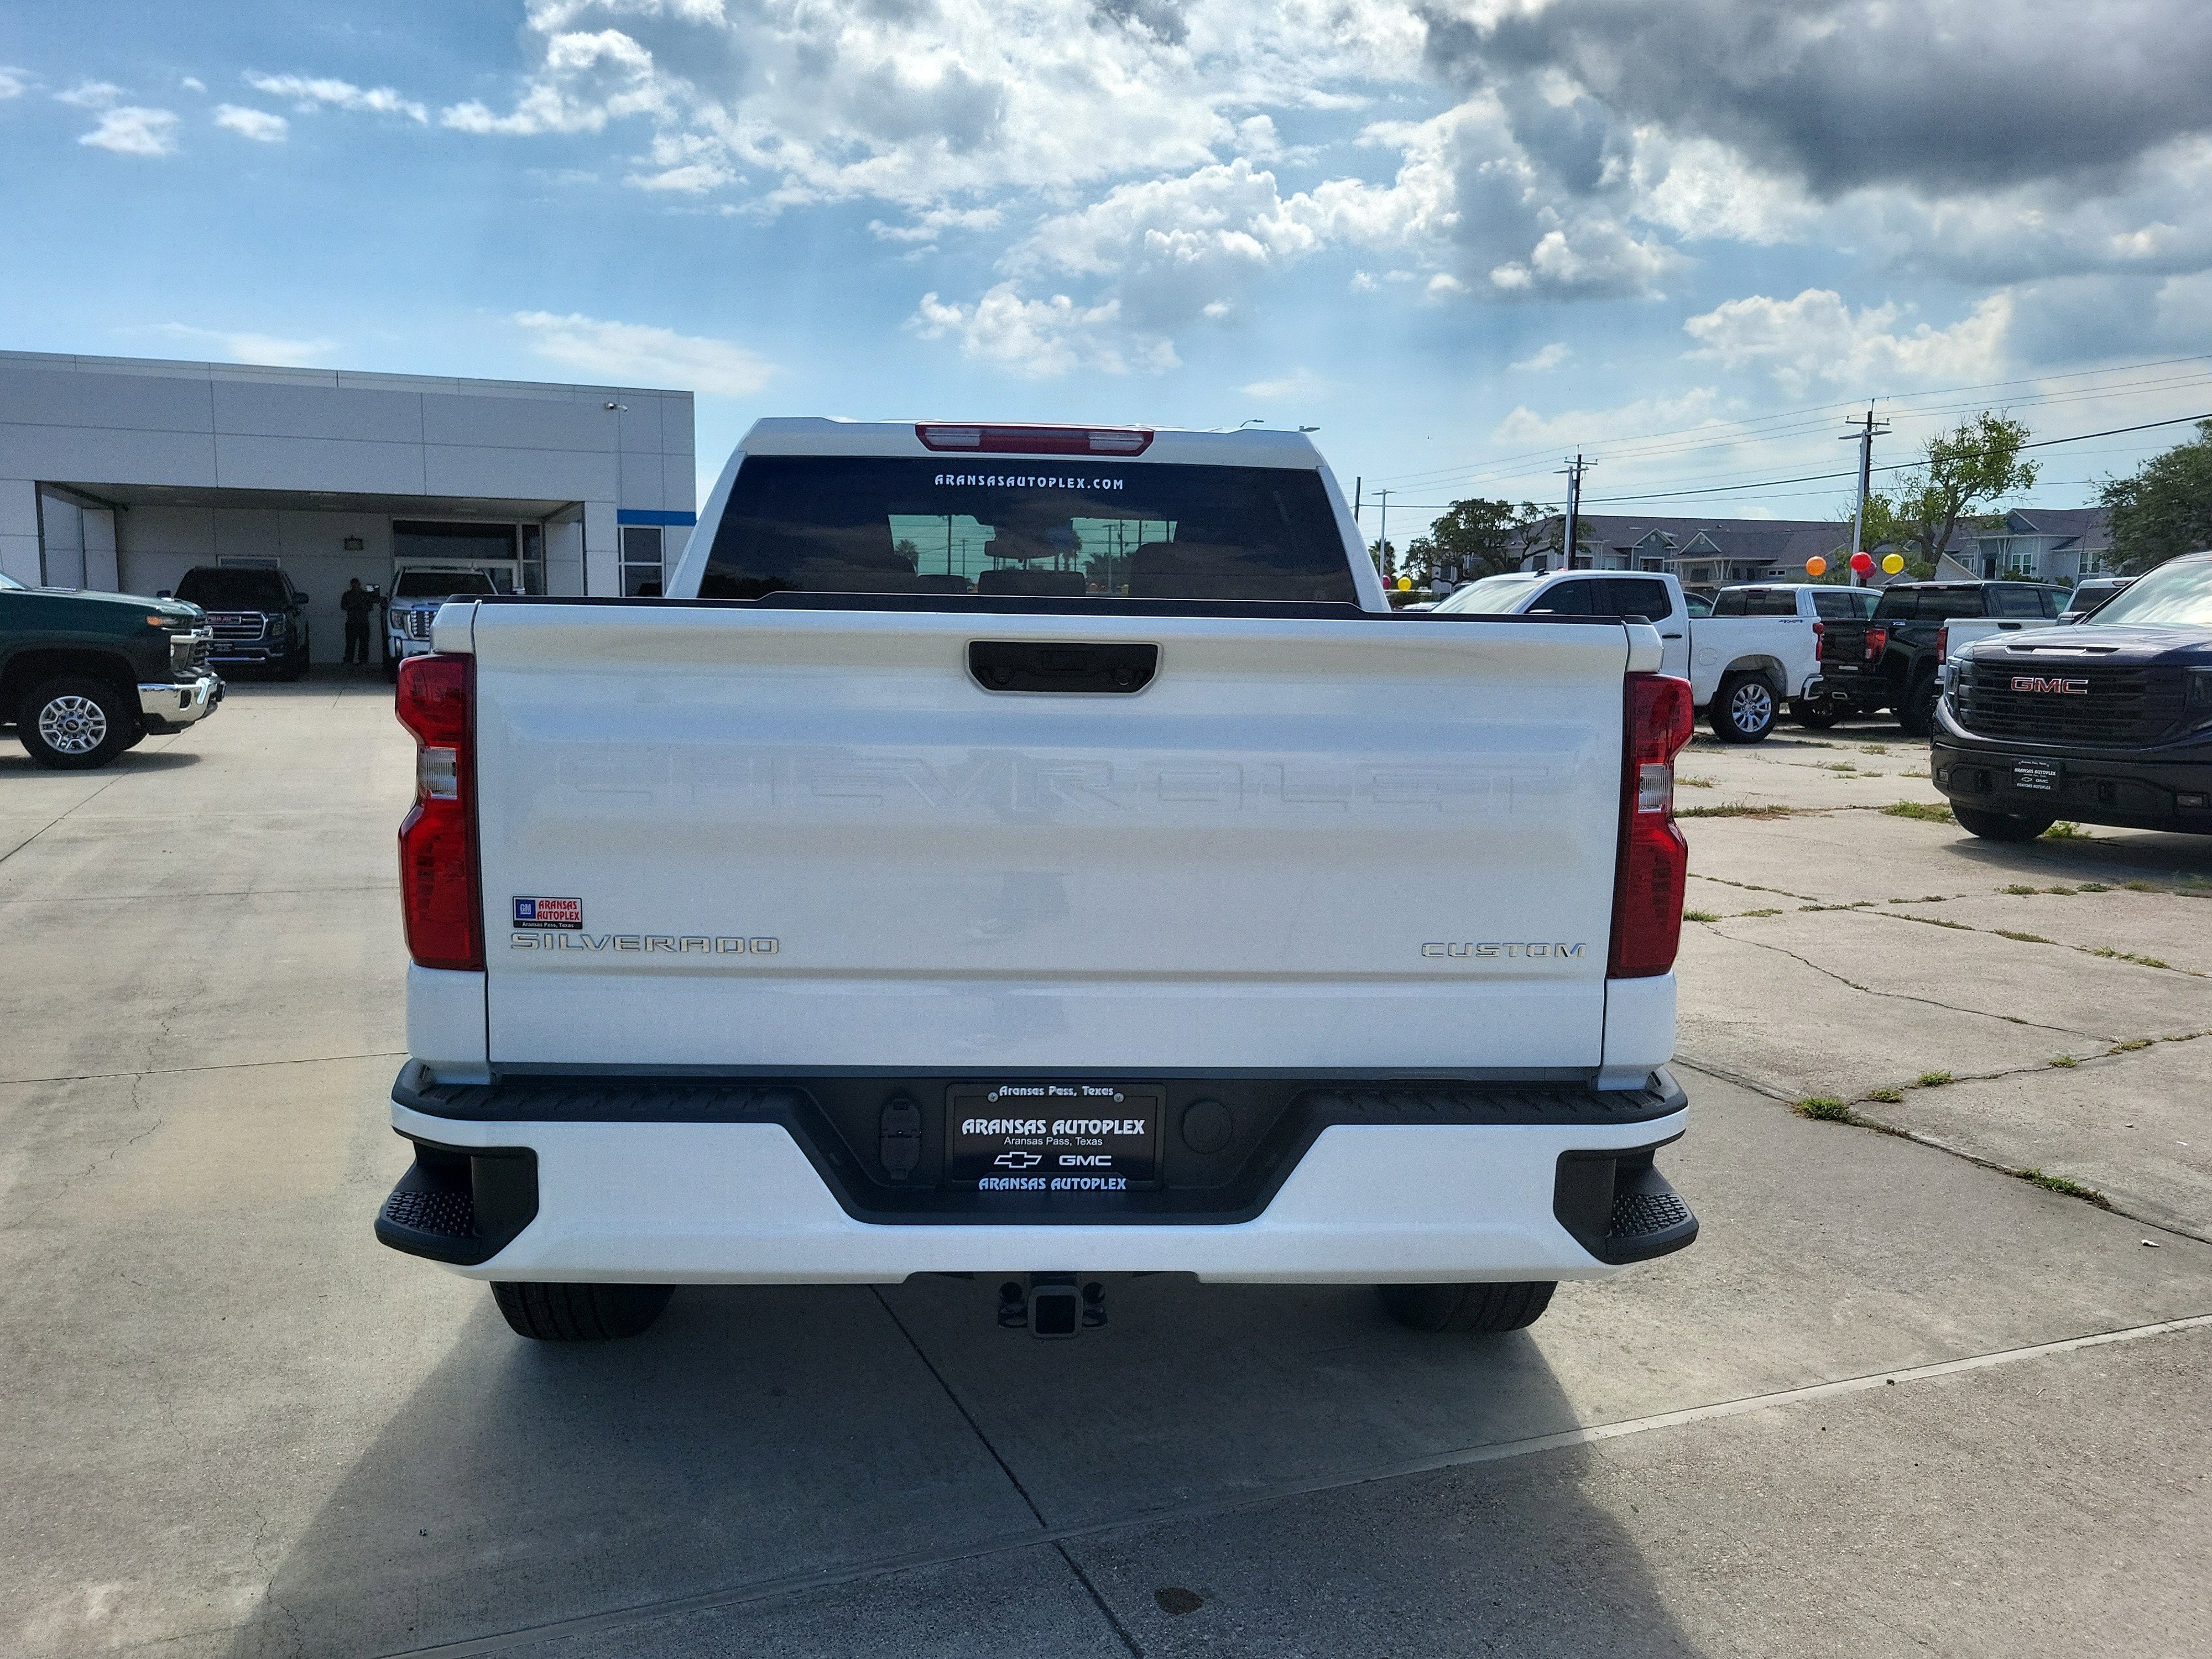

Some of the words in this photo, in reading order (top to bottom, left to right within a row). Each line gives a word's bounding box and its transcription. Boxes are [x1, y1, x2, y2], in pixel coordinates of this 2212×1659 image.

[935, 474, 1123, 490] ARANSASAUTOPLEX.COM
[2011, 676, 2089, 695] GMC
[555, 753, 1550, 813] CHEVROLET
[520, 904, 531, 912] GM
[539, 900, 577, 910] ARANSAS
[537, 911, 580, 920] AUTOPLEX
[510, 932, 779, 954] SILVERADO
[1421, 942, 1587, 957] CUSTOM
[999, 1086, 1045, 1096] Aransas
[1048, 1086, 1077, 1097] Pass,
[1082, 1086, 1114, 1096] Texas
[962, 1119, 1047, 1135] ARANSAS
[1052, 1119, 1145, 1136] AUTOPLEX
[1004, 1136, 1043, 1145] Aransas
[1046, 1137, 1072, 1146] Pass,
[1075, 1137, 1103, 1145] Texas
[1059, 1155, 1112, 1166] GMC
[979, 1178, 1046, 1190] ARANSAS
[1051, 1178, 1126, 1190] AUTOPLEX
